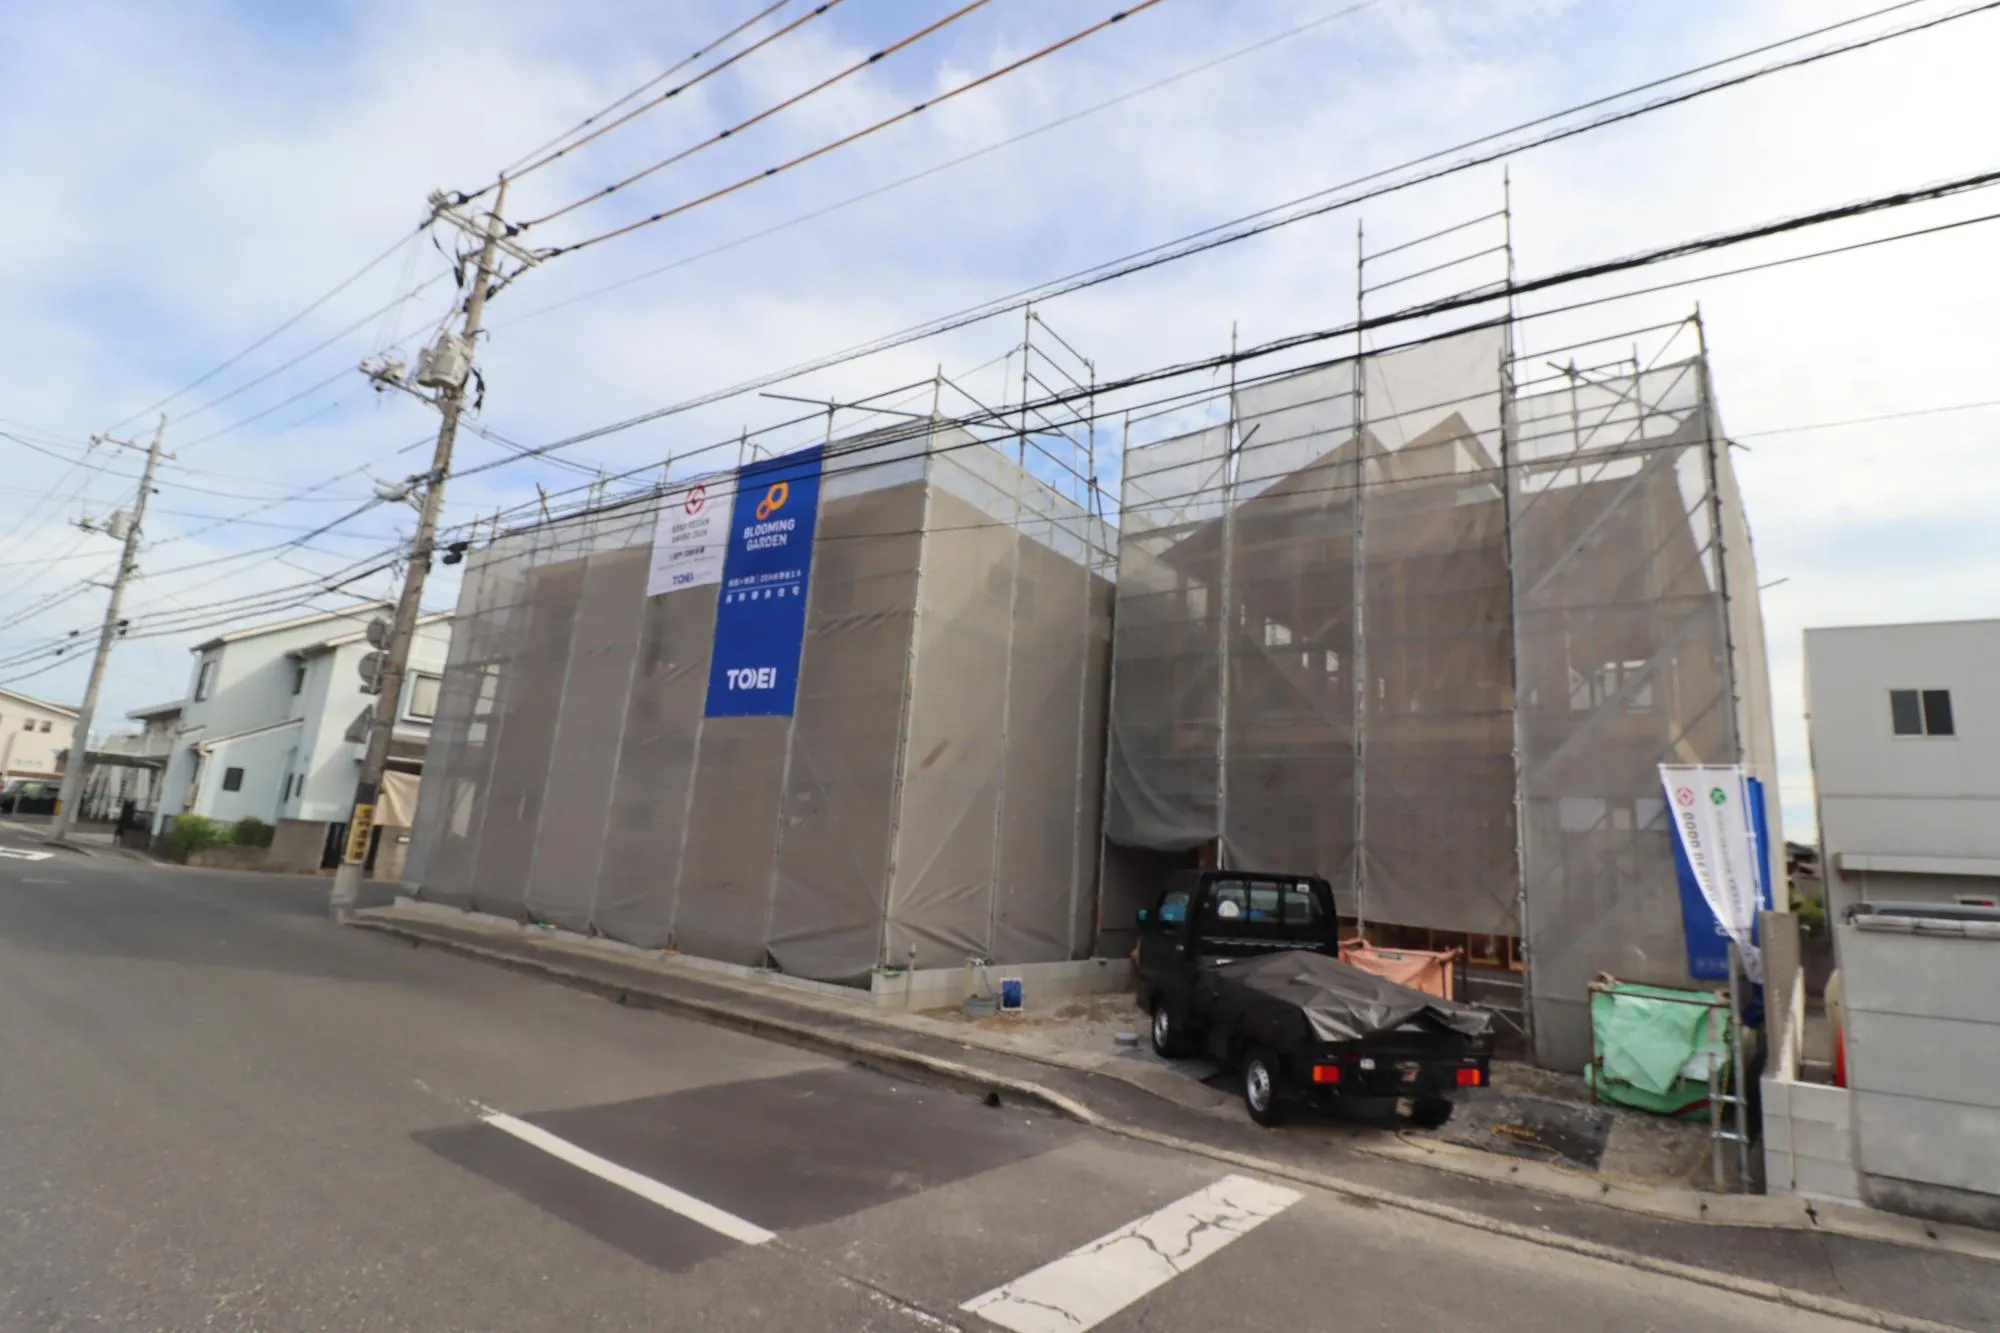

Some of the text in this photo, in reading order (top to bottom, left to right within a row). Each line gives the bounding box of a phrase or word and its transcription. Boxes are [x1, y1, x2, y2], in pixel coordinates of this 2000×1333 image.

[743, 518, 796, 540] BLOOMING
[746, 533, 788, 551] GARDEN
[727, 667, 777, 690] TOEI
